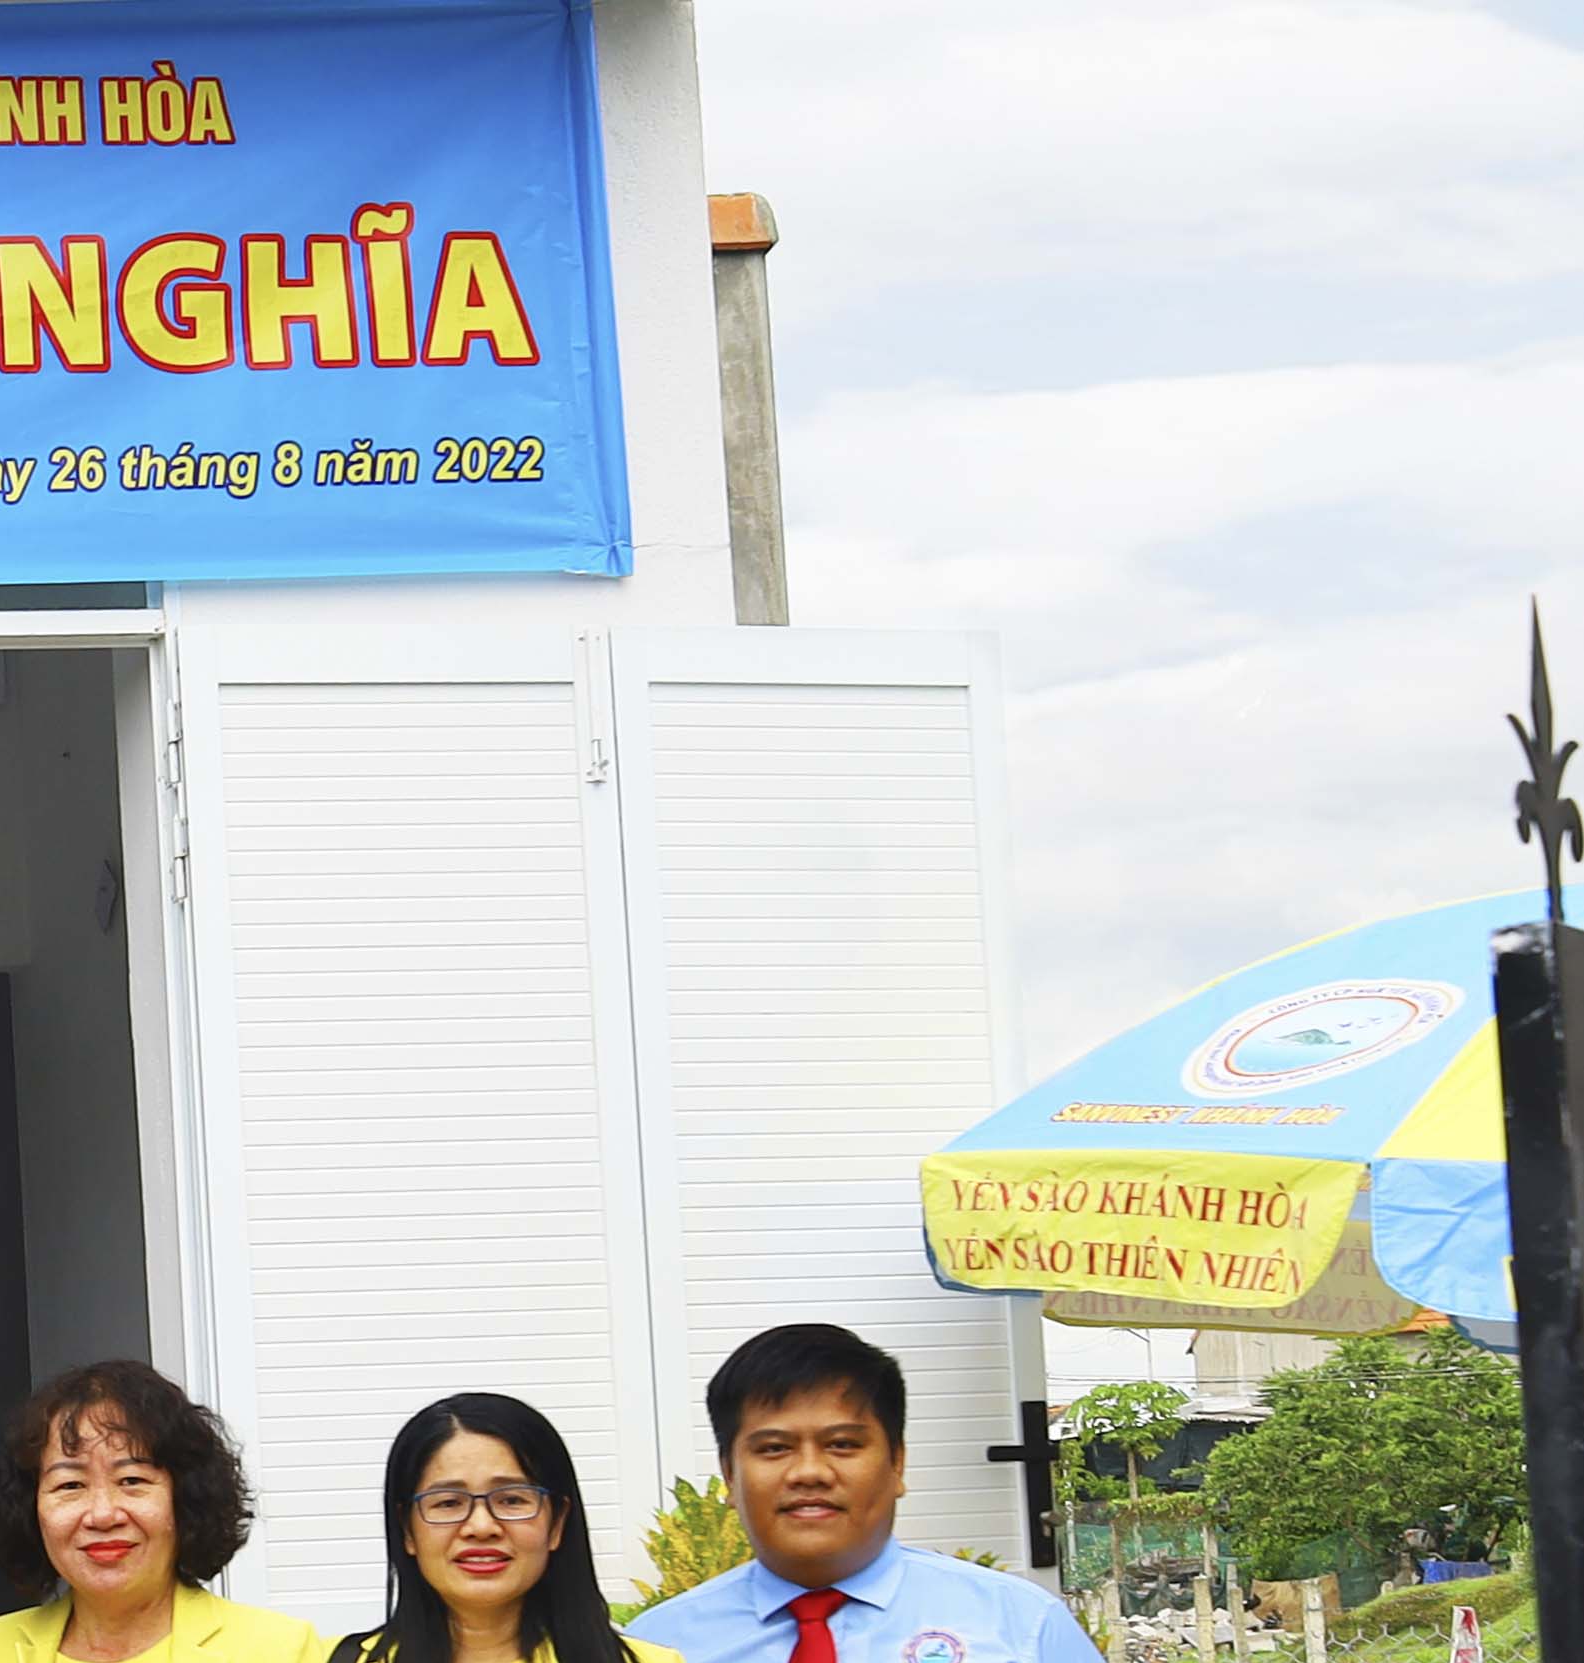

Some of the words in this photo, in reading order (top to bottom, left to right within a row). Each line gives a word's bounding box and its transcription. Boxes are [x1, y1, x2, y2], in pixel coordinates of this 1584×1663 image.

[101, 62, 236, 145] HÒA
[50, 448, 106, 495] 26
[121, 442, 257, 498] tháng
[275, 440, 302, 488] 8
[316, 438, 416, 488] năm
[433, 435, 545, 485] 2022
[950, 1172, 1013, 1212] YẾN
[1020, 1171, 1090, 1212] SÀO
[1096, 1174, 1224, 1221] KHÁNH
[1238, 1182, 1308, 1231] HÒA
[944, 1229, 1006, 1271] YẾN
[1013, 1230, 1073, 1271] SÀO
[1081, 1234, 1186, 1286] THIÊN
[1200, 1245, 1304, 1295] NHIÊN
